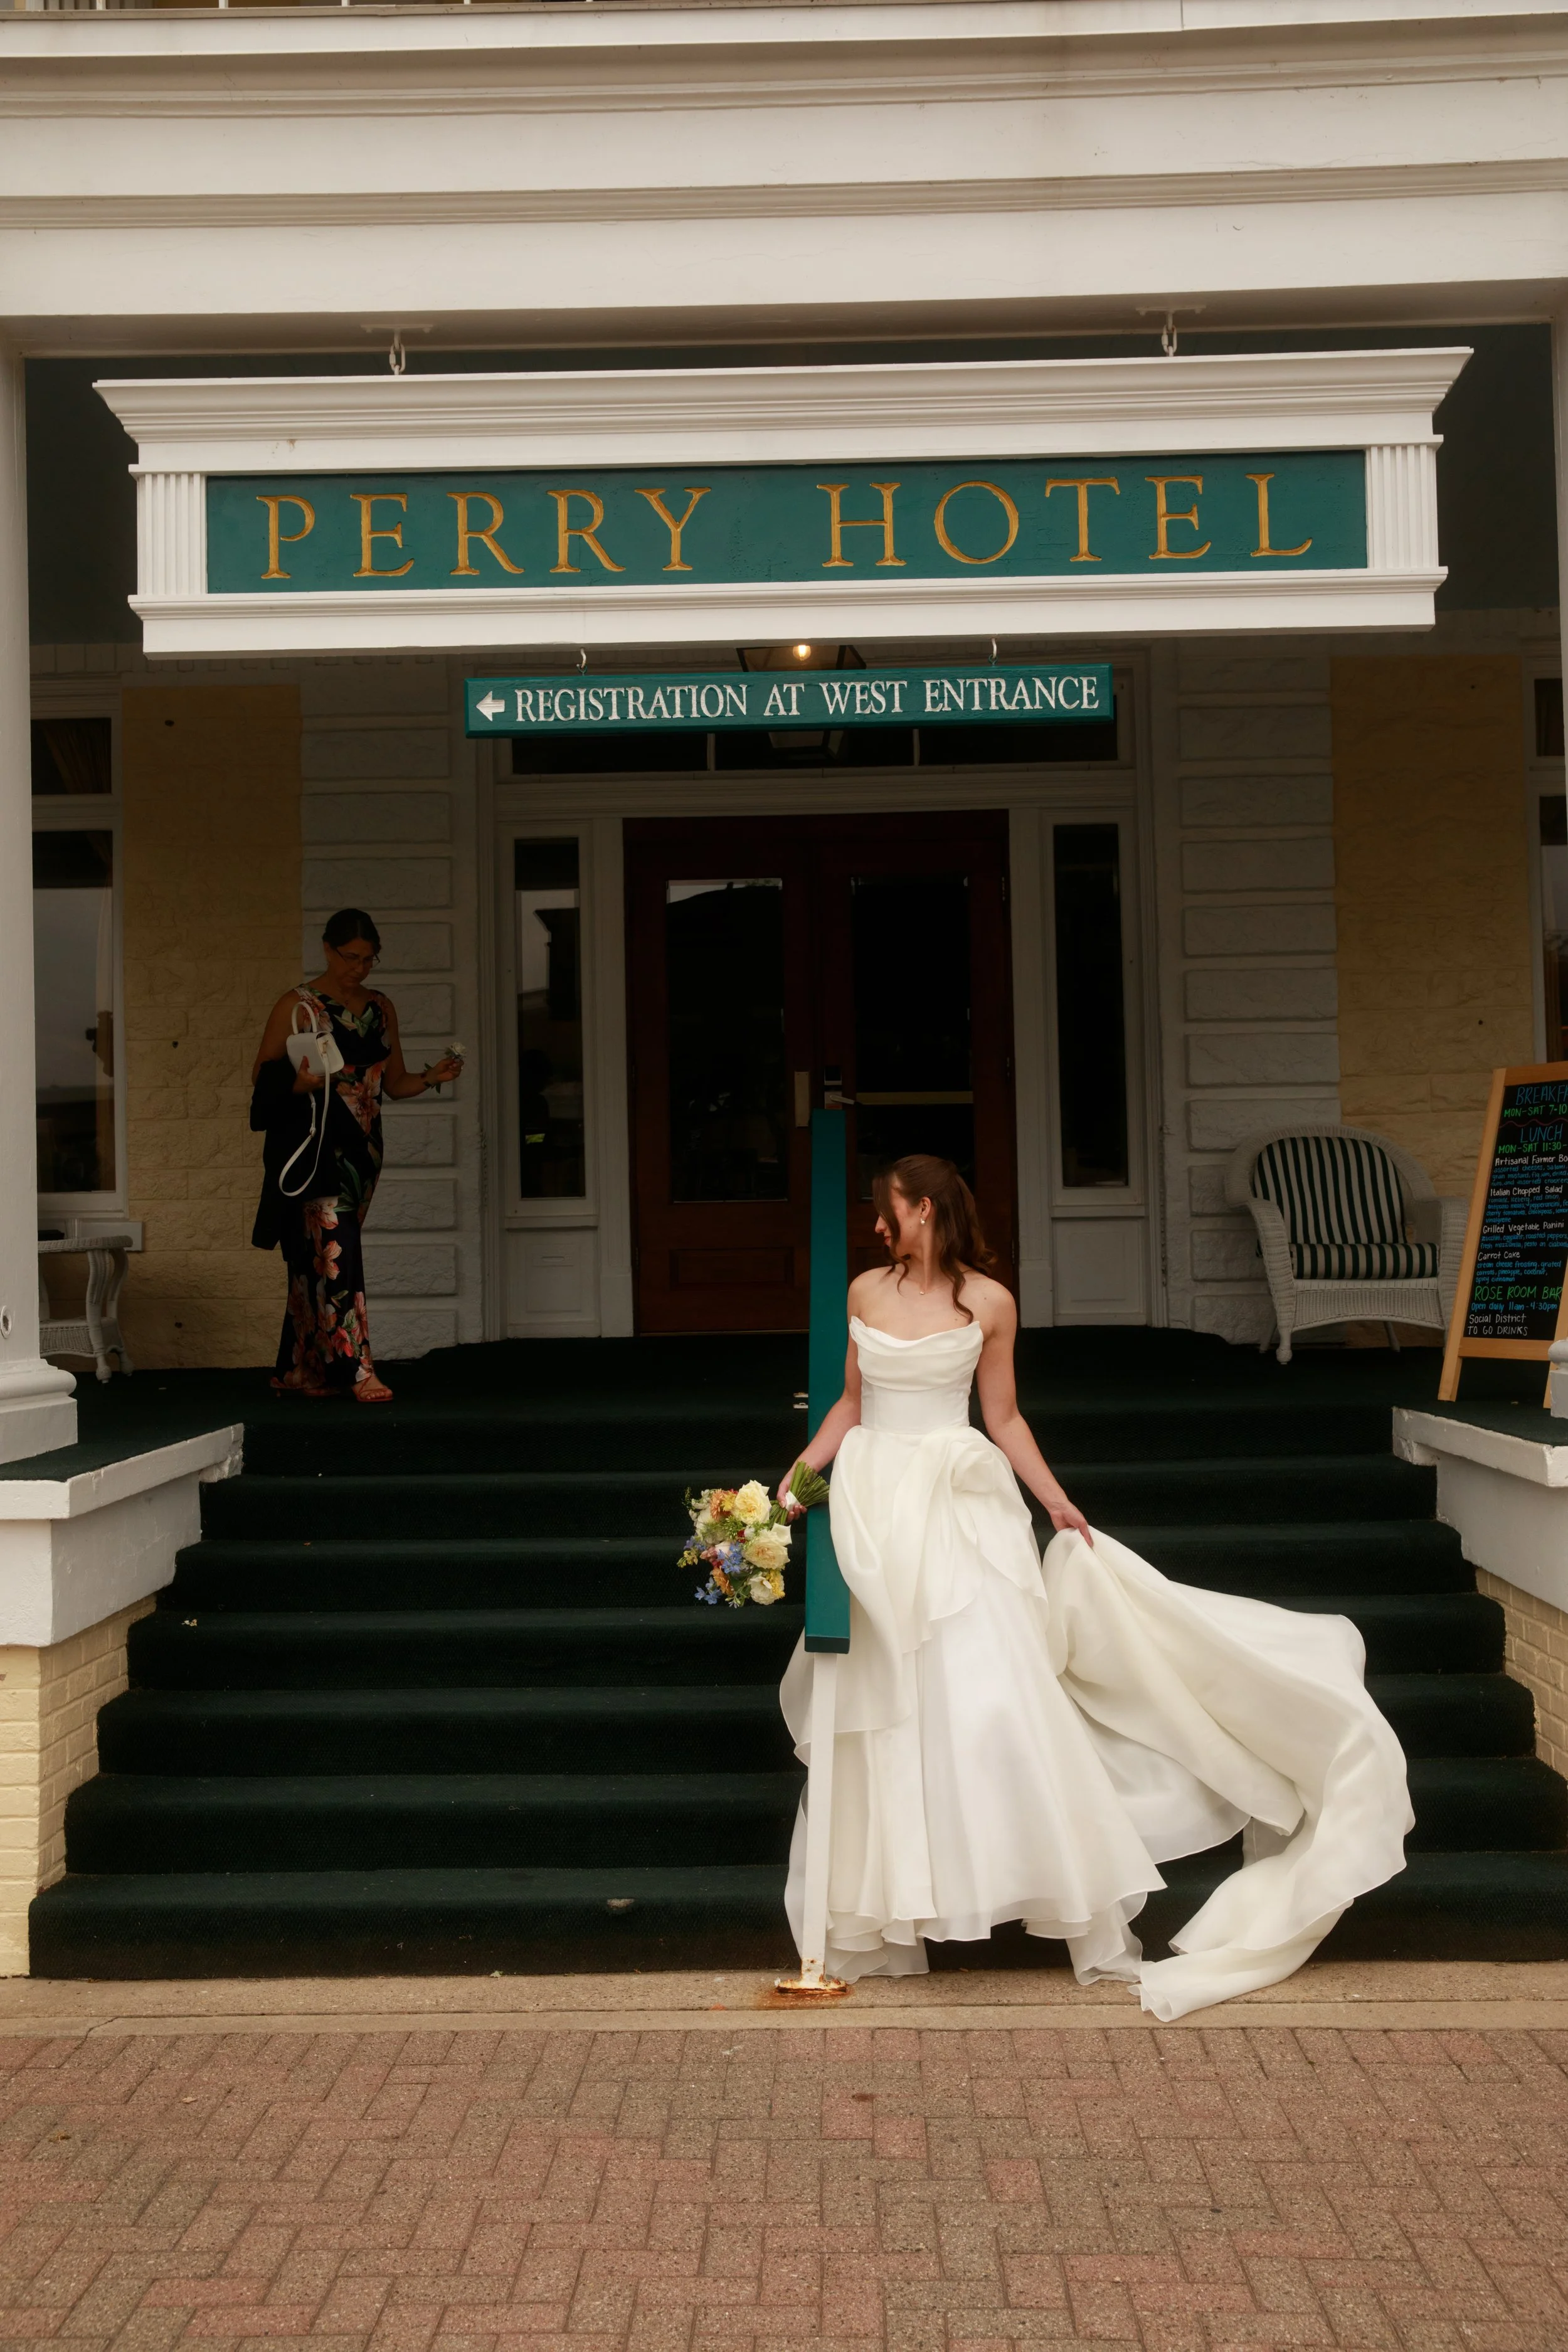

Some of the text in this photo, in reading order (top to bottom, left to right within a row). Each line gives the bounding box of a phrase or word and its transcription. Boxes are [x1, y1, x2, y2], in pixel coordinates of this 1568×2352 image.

[256, 473, 1312, 580] PERRY HOTEL
[515, 676, 1099, 723] REGISTRATION AT WEST ENTRANCE
[1503, 1105, 1545, 1118] MON-SAT
[1520, 1123, 1563, 1143] LUNCH
[1498, 1142, 1539, 1153] MON-SAT
[1495, 1154, 1568, 1166] Artisanal Farmer Bo
[1513, 1185, 1540, 1196] Chopped
[1545, 1185, 1563, 1194] Salad
[1483, 1219, 1564, 1234] Grilled Vegetable Panini
[1478, 1252, 1501, 1261] Carrot
[1475, 1285, 1562, 1301] ROSE ROOM BAR
[1471, 1302, 1486, 1312] Open
[1489, 1302, 1505, 1313] daily
[1469, 1313, 1527, 1324] Social District
[1468, 1326, 1528, 1336] TO GO DRINKS
